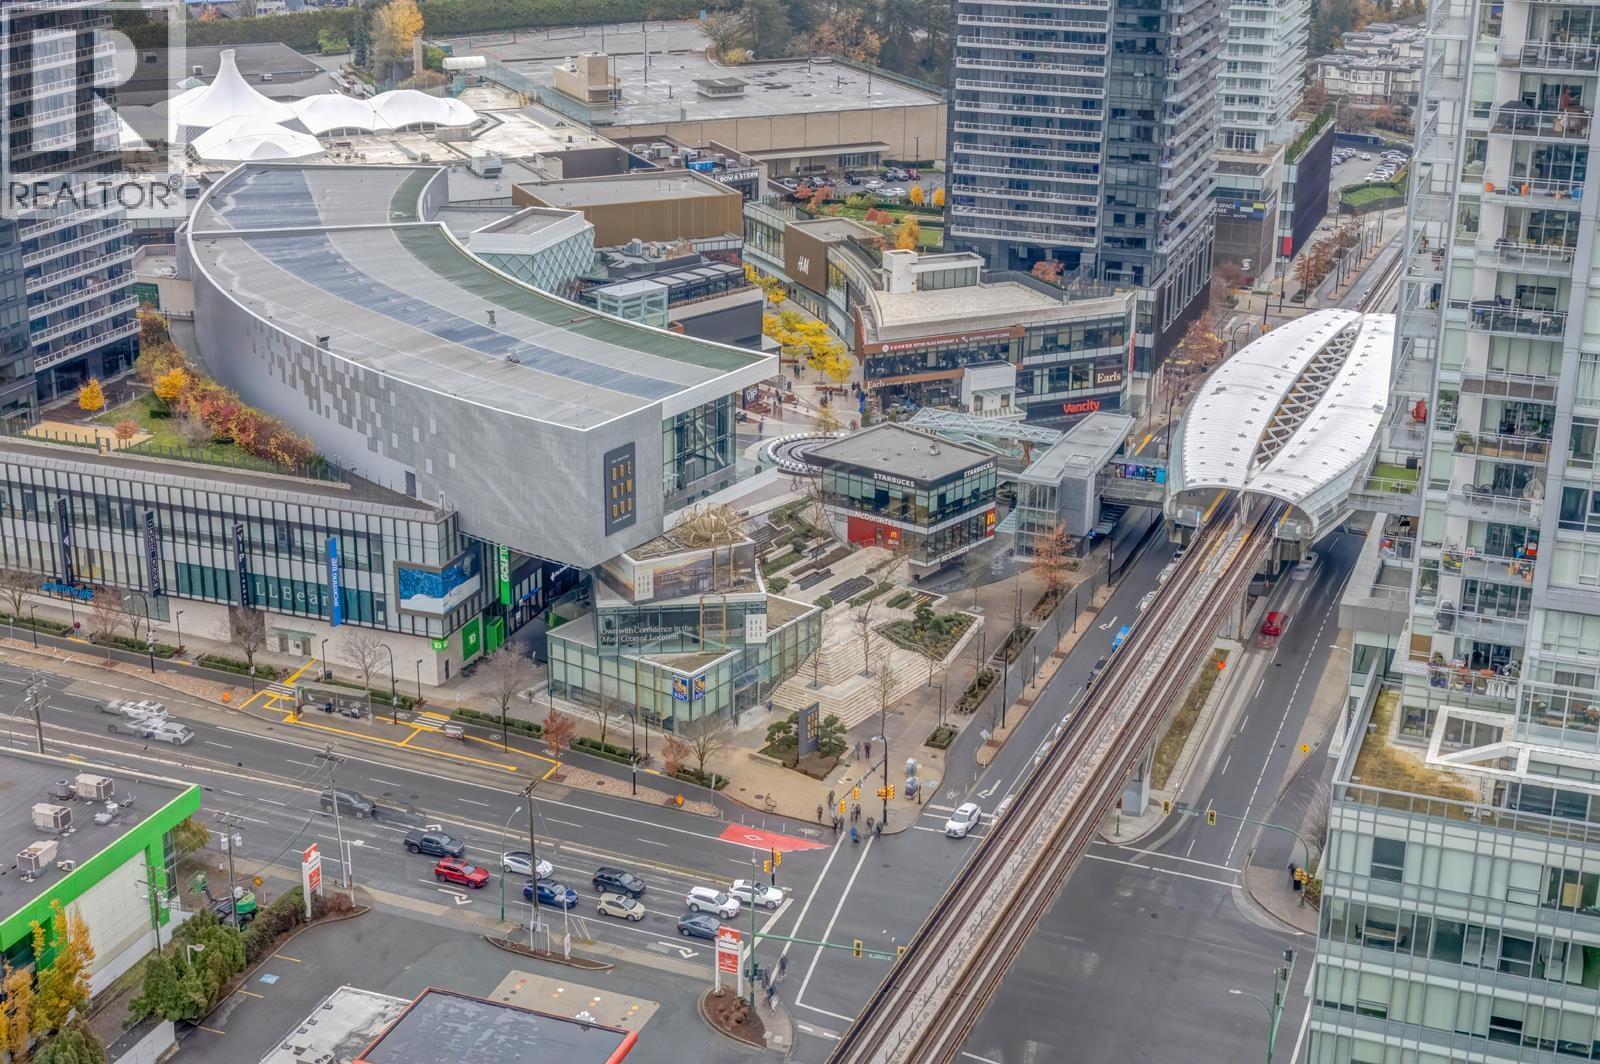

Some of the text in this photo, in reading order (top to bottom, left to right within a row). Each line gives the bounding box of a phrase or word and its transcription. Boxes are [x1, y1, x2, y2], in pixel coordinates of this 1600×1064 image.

[1096, 371, 1122, 384] Earls
[1063, 400, 1100, 415] Vancity
[964, 461, 994, 479] STARBUCKS
[873, 472, 915, 488] STARBUCKS
[237, 533, 245, 562] VIP
[620, 626, 634, 634] with
[634, 625, 673, 633] Confidence
